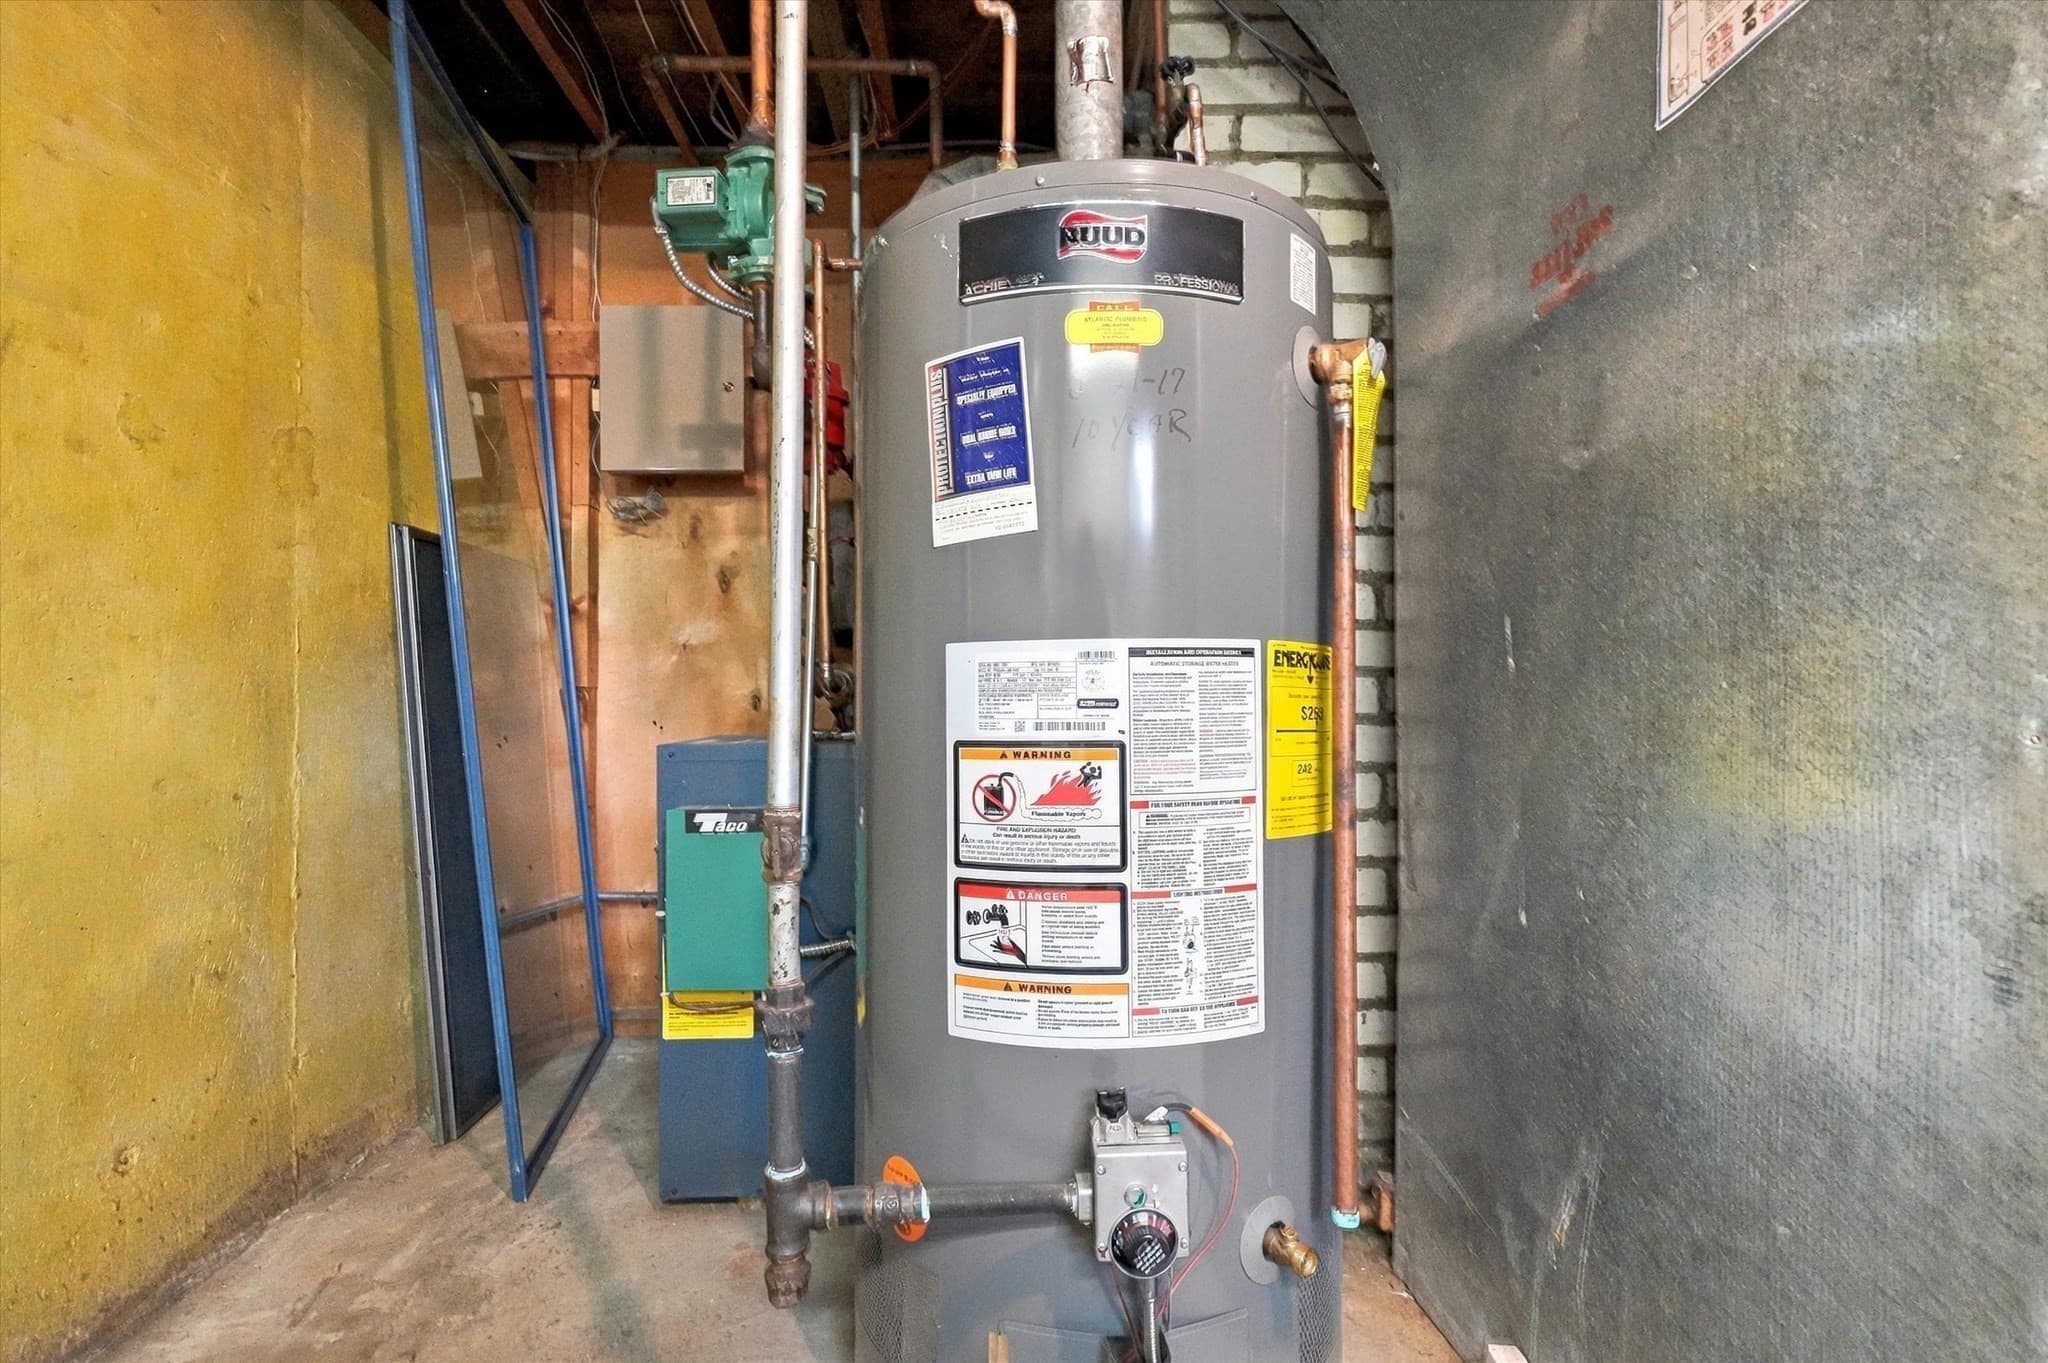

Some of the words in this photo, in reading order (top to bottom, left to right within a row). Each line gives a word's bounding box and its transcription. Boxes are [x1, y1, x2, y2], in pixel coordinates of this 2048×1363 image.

[1060, 225, 1146, 247] RUUD
[1013, 750, 1072, 760] WARNING
[693, 813, 748, 833] Taco
[1018, 890, 1068, 900] DANGER
[1018, 983, 1072, 994] WARNING
